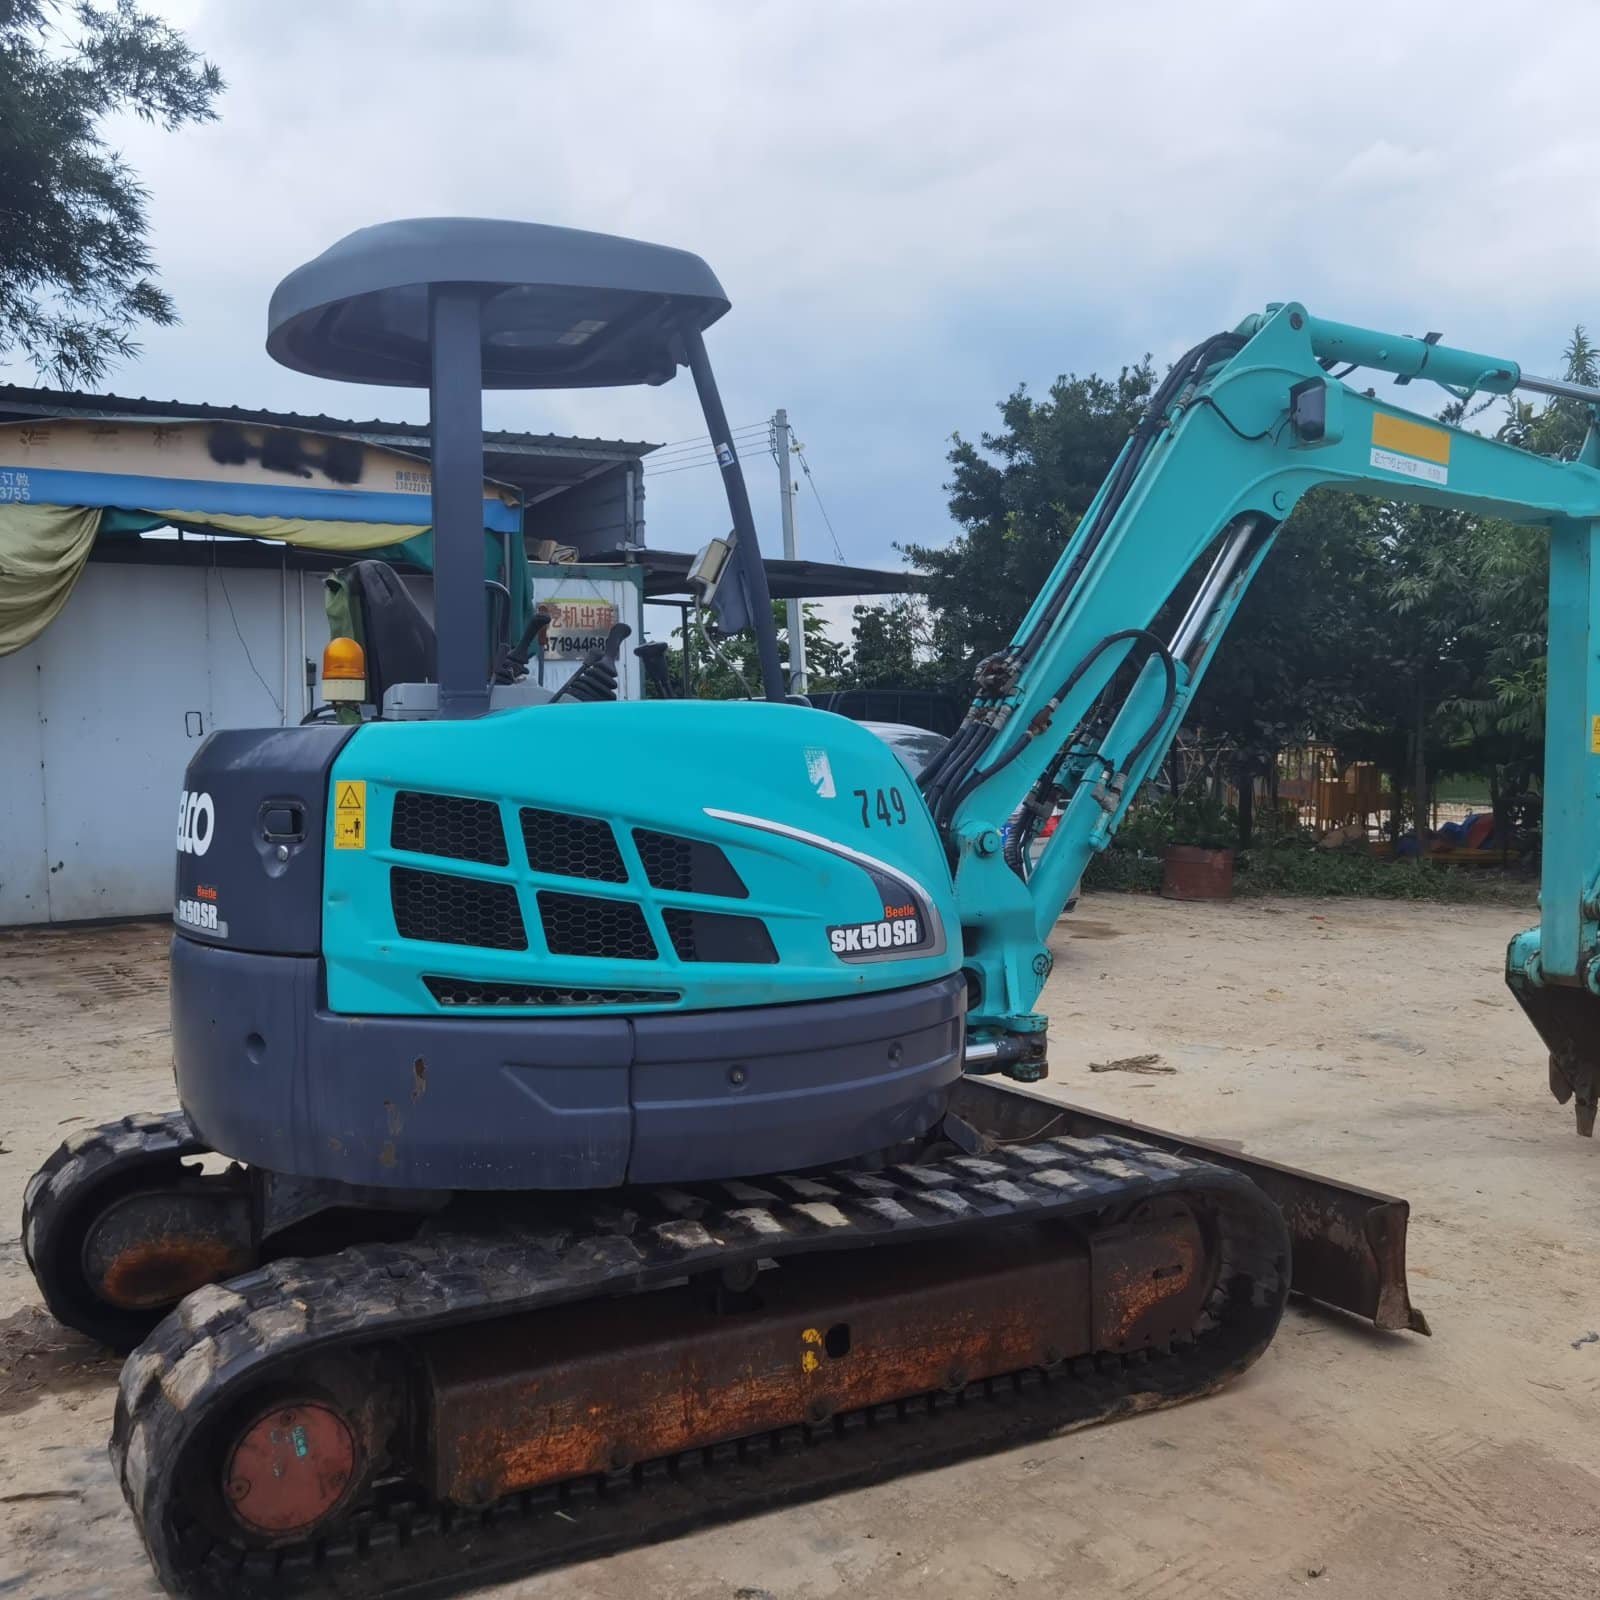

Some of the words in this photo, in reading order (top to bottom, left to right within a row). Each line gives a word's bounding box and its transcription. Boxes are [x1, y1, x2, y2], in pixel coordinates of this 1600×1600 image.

[854, 786, 907, 828] 749
[197, 885, 217, 898] Beetle
[885, 905, 915, 918] Beetle
[831, 920, 917, 952] SK50SR
